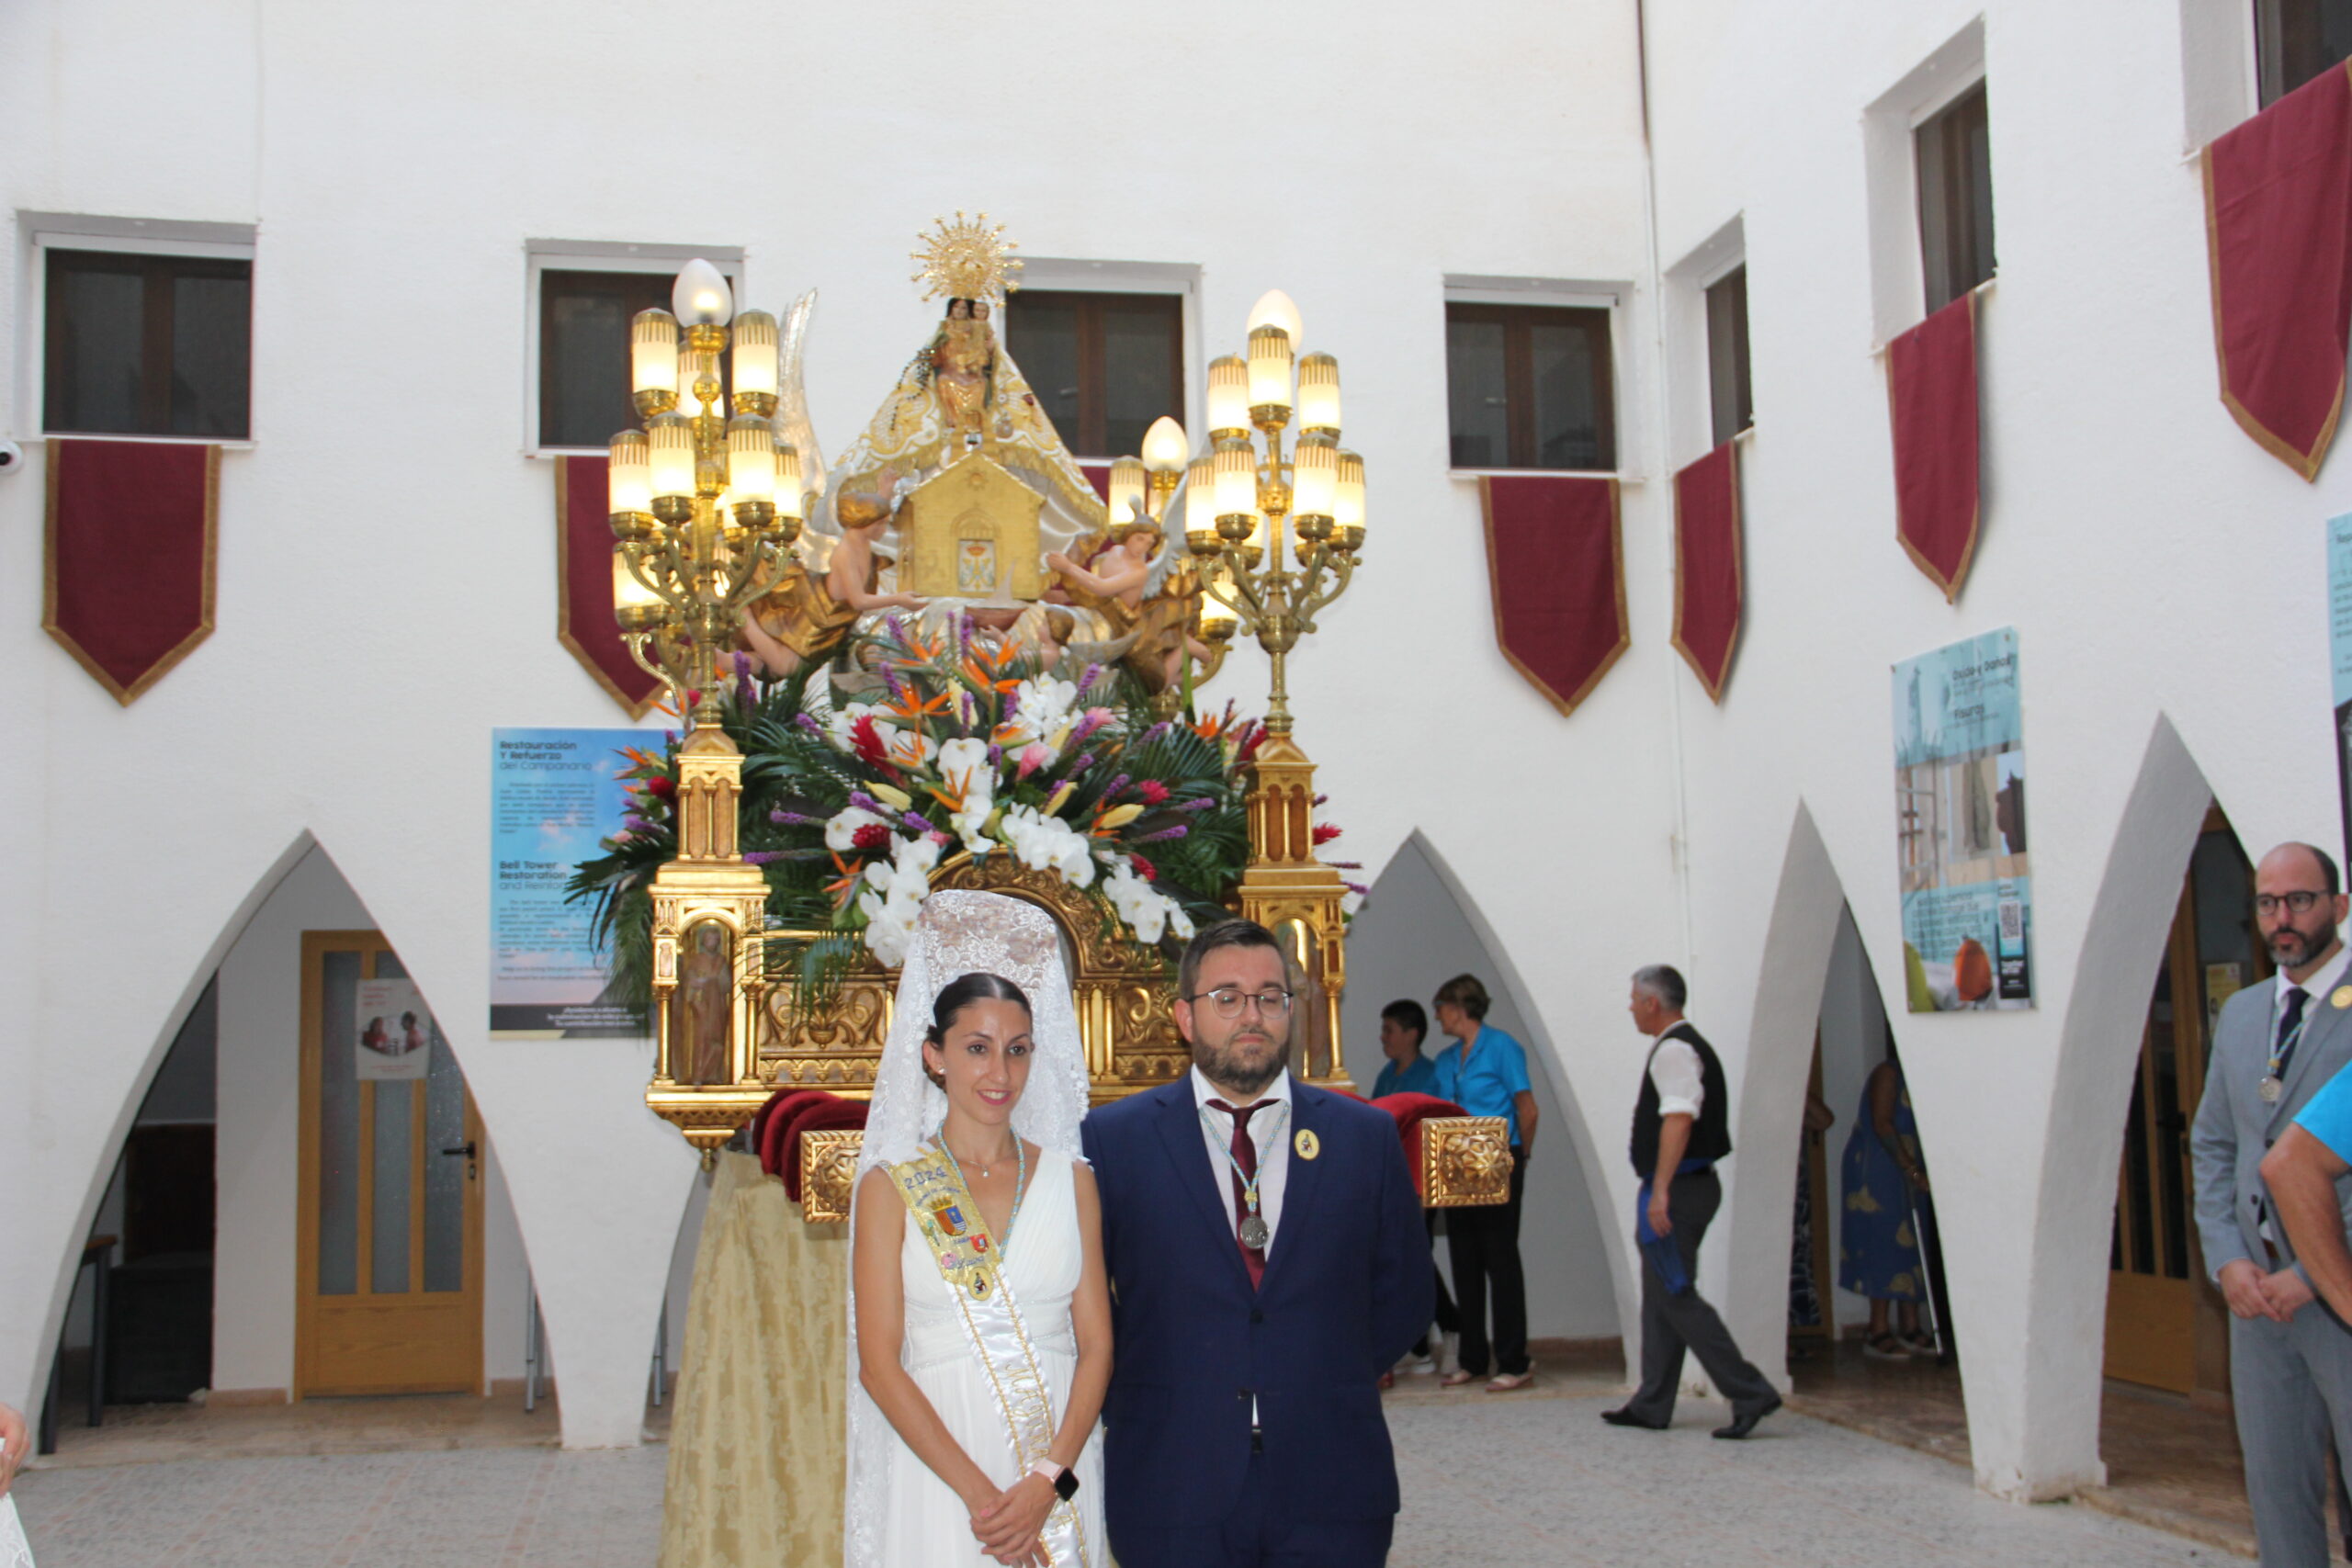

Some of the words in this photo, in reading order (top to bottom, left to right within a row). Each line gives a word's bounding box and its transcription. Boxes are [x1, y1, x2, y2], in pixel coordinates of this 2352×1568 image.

[500, 739, 577, 750] Restauración
[500, 751, 507, 760] Y
[511, 750, 562, 760] Refuerzo
[500, 761, 516, 770] del
[521, 761, 593, 771] Campanario
[500, 860, 520, 869] Bell
[525, 861, 558, 869] Tower
[500, 871, 567, 879] Restoration
[500, 881, 522, 889] and
[526, 881, 564, 890] Reinfor
[904, 1166, 948, 1190] 2024
